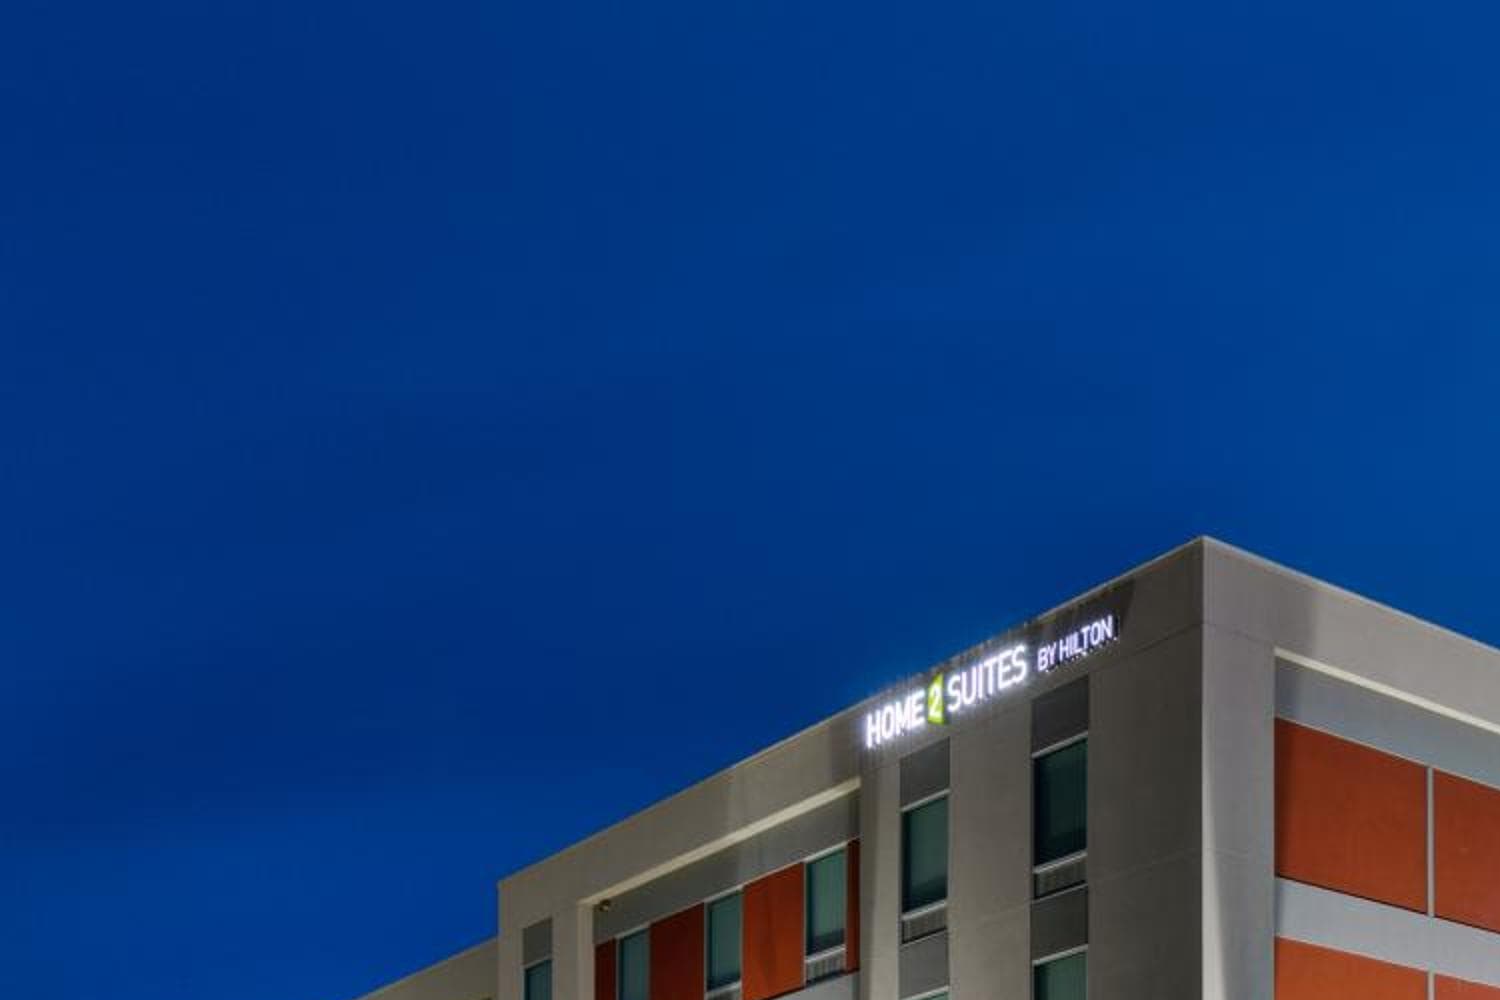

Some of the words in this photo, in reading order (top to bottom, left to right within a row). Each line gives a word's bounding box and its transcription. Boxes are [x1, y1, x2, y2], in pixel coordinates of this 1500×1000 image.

[865, 690, 925, 748] HOME
[929, 682, 943, 718] 2
[946, 645, 1028, 712] SUITES
[1037, 641, 1057, 671] BY
[1059, 614, 1113, 662] HILTON
